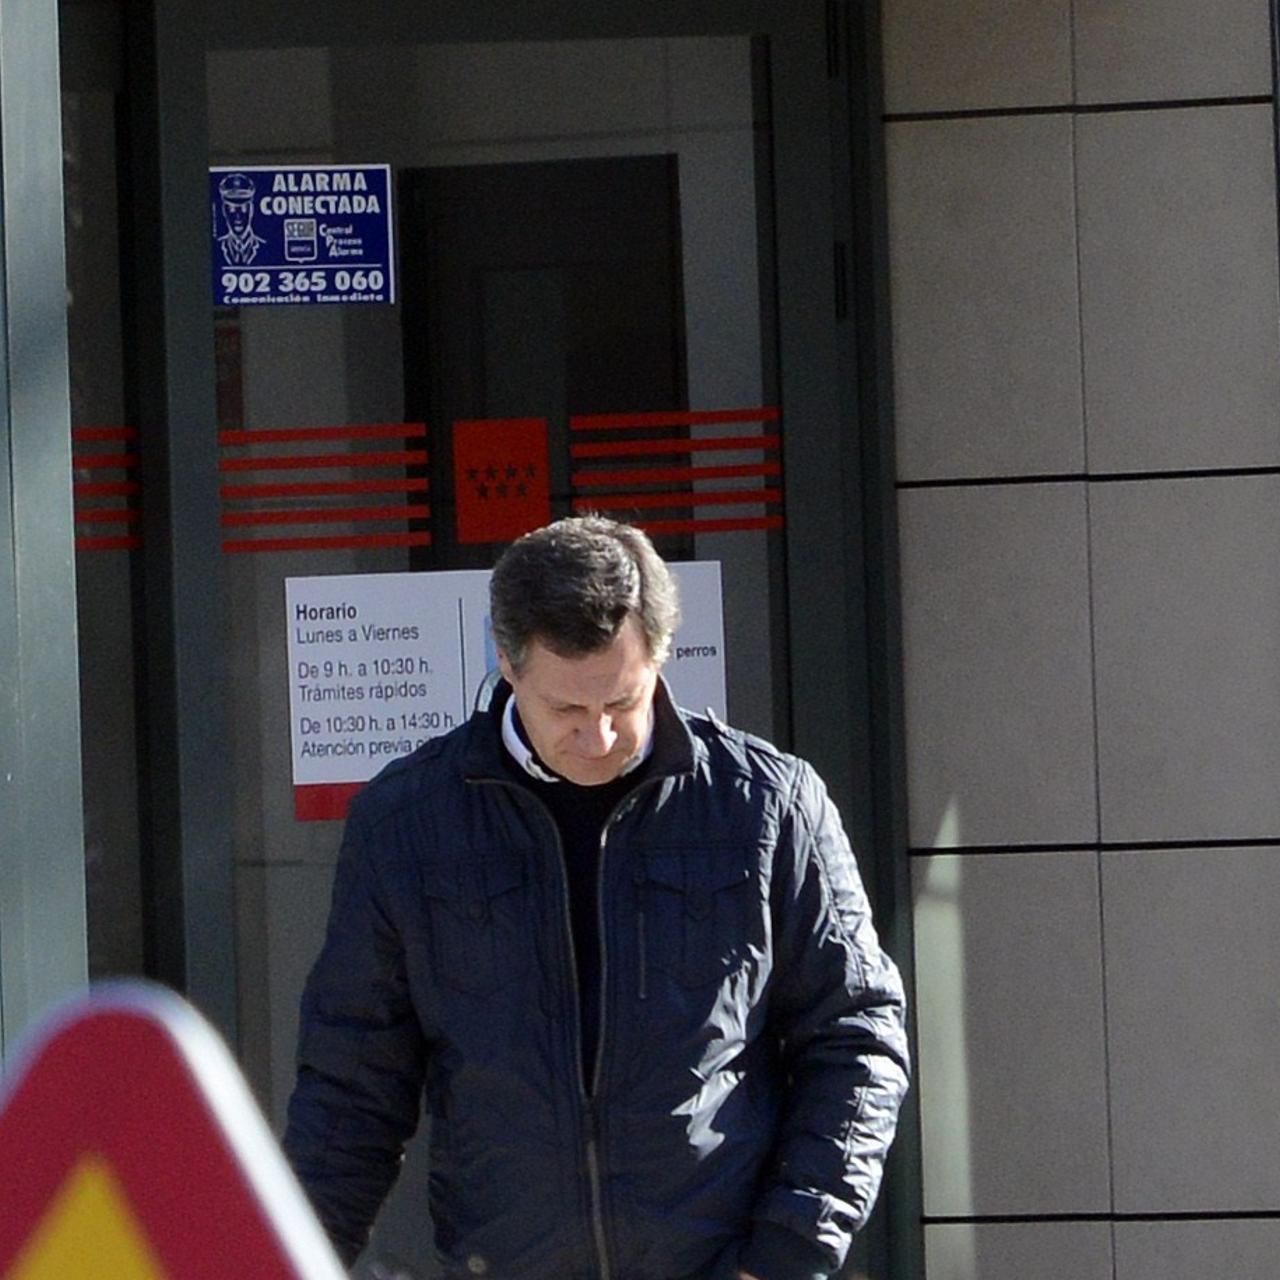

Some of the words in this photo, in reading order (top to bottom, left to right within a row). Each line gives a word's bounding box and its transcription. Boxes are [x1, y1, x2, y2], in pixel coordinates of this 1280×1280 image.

[273, 173, 367, 192] ALARMA
[260, 196, 381, 215] CONECTADA
[221, 273, 270, 294] 902
[278, 271, 327, 293] 365
[334, 270, 384, 291] 060
[296, 603, 357, 620] Horario
[296, 627, 343, 644] Lunes
[348, 629, 357, 642] a
[361, 624, 420, 641] Viernes
[676, 646, 717, 659] perros
[298, 662, 319, 679] De
[324, 660, 333, 677] 9
[338, 660, 352, 677] h.
[358, 663, 367, 677] a
[373, 658, 414, 675] 10:30
[419, 657, 432, 674] h.
[299, 684, 365, 702] Trámites
[369, 682, 427, 701] rápidos
[301, 716, 321, 734] De
[327, 716, 365, 733] 10:30
[369, 714, 382, 732] h.
[386, 716, 396, 731] a
[401, 712, 440, 730] 14:30
[301, 738, 364, 758] Atención
[369, 739, 412, 758] previa
